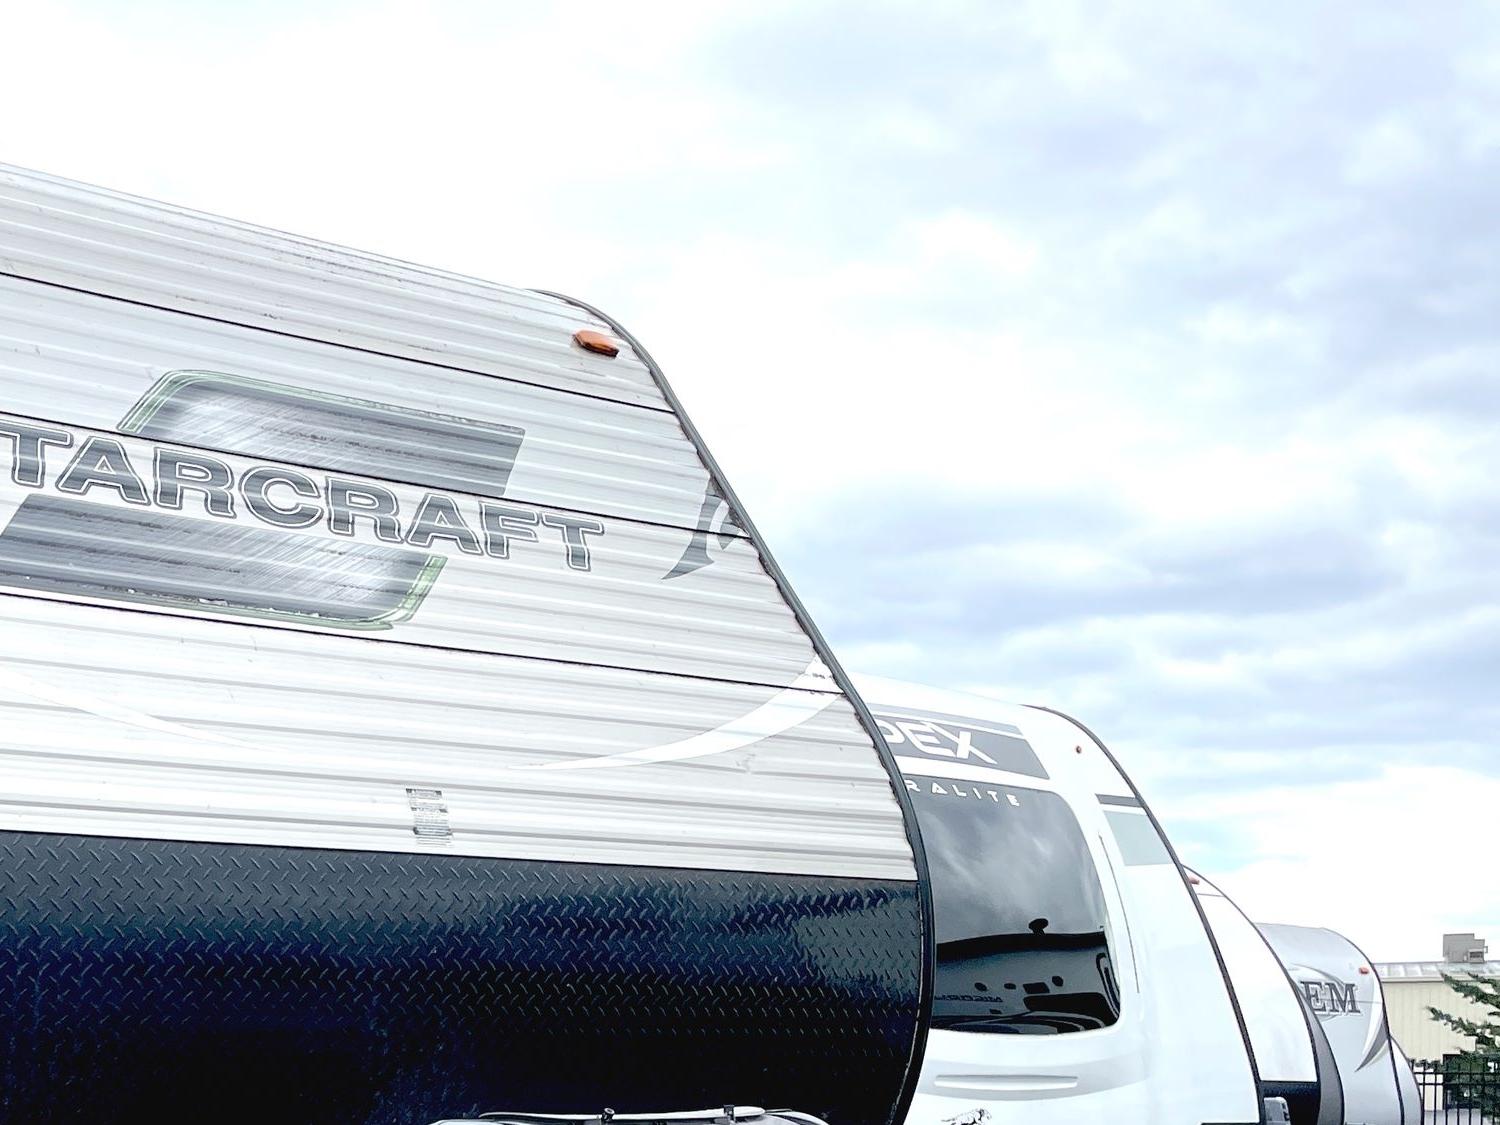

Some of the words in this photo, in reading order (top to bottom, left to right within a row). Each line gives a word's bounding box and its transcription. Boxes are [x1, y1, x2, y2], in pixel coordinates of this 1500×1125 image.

[873, 718, 999, 765] PEX
[903, 779, 1021, 807] RALITE
[1300, 980, 1362, 1015] EM
